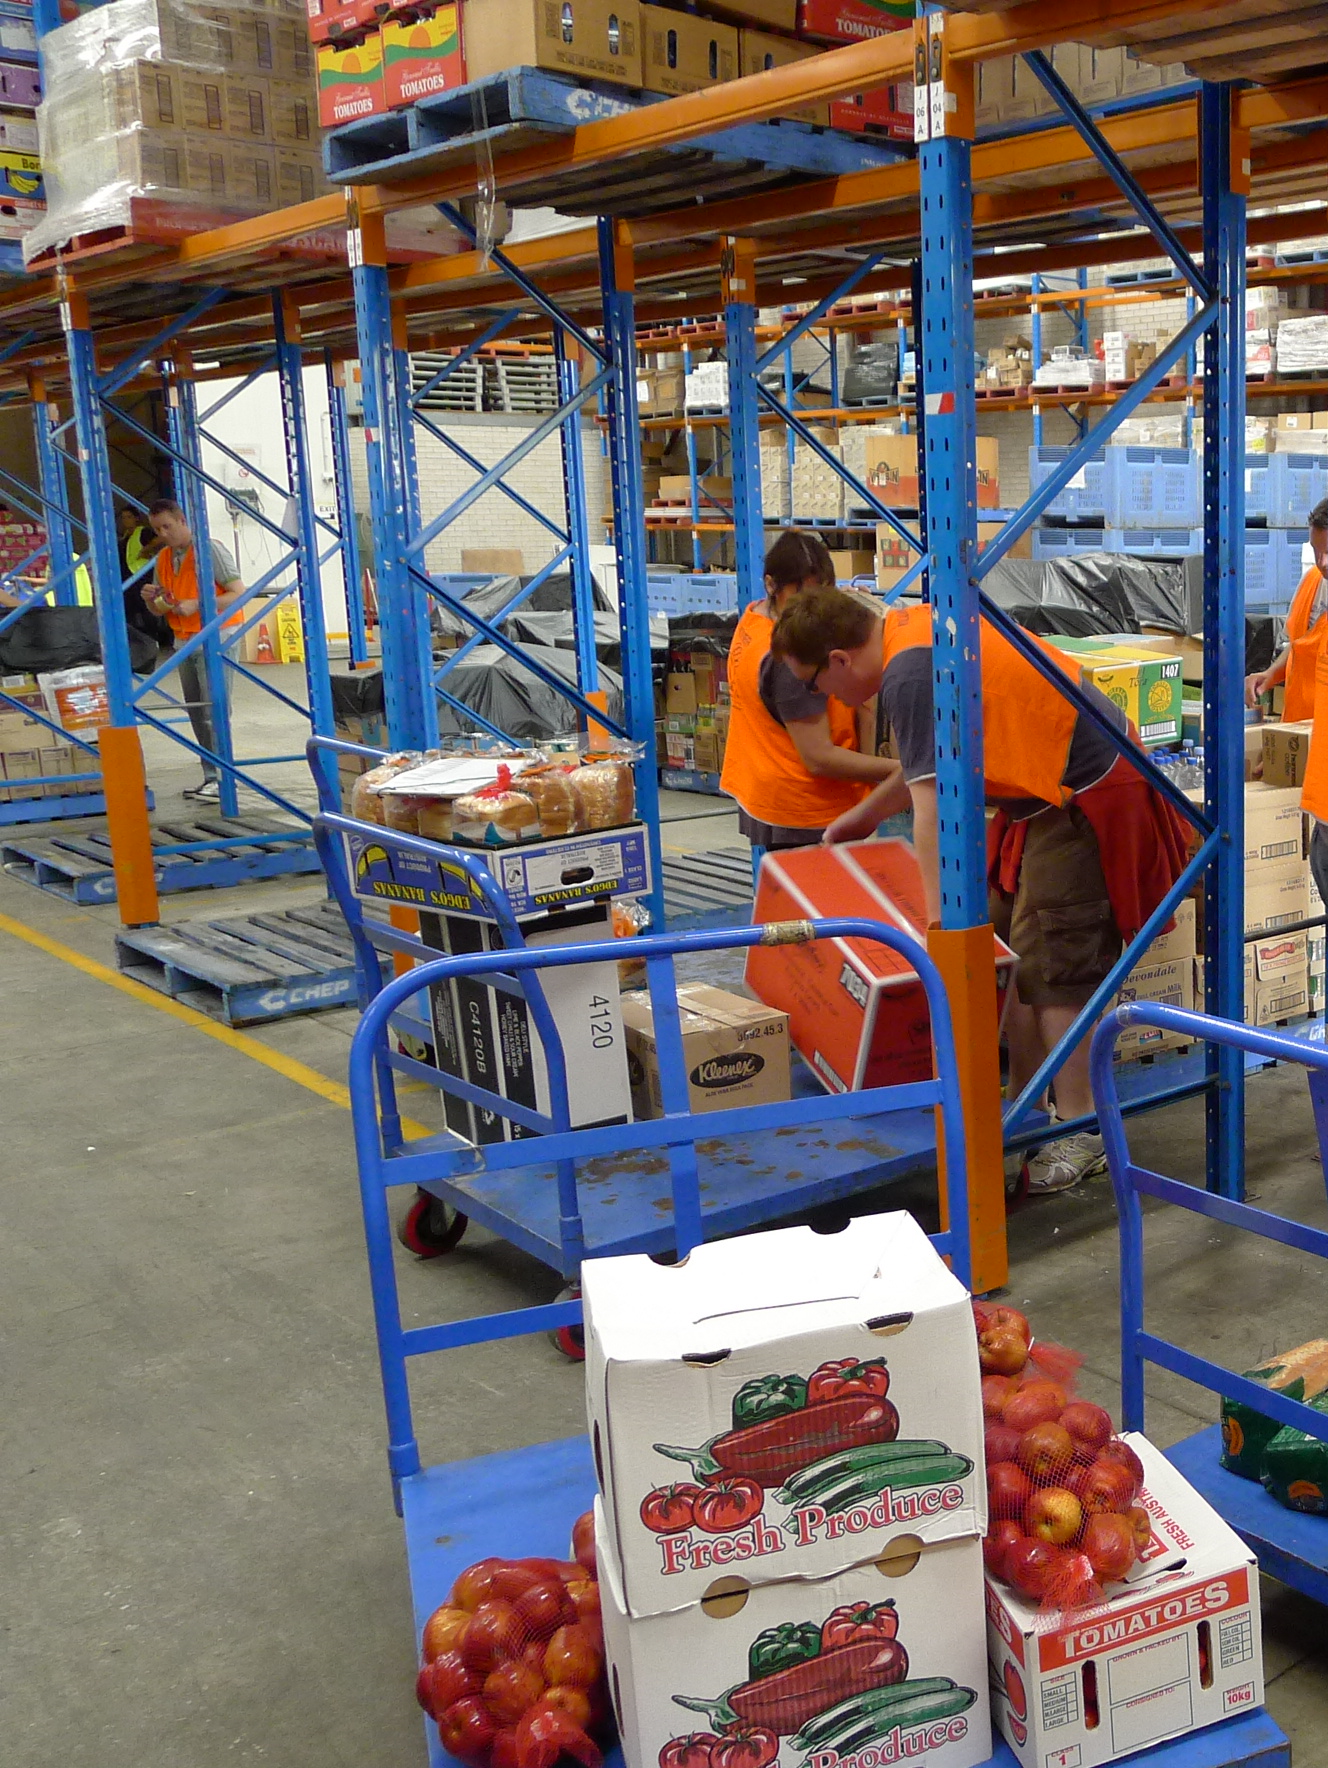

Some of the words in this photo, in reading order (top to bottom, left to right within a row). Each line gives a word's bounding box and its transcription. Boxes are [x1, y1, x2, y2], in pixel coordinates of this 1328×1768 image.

[835, 18, 891, 38] TOMATO
[399, 74, 445, 98] TOMATOES
[333, 98, 373, 119] TOMATOES
[916, 106, 925, 118] 06
[932, 103, 942, 114] 04
[917, 125, 924, 135] A
[935, 121, 941, 131] A
[319, 505, 336, 513] EXIT
[1161, 663, 1180, 679] 1407
[372, 881, 425, 903] BANANAS
[535, 887, 583, 905] BANANAS
[584, 879, 619, 896] EDGO'S
[431, 891, 471, 910] EDGO'S
[289, 979, 350, 1003] CHEP
[588, 993, 615, 1050] 4120
[469, 1001, 487, 1074] C4120B
[698, 1056, 756, 1083] Kleenex
[656, 1513, 785, 1575] Fresh
[793, 1483, 964, 1547] Produce
[1161, 1519, 1196, 1551] FRESH
[1063, 1580, 1230, 1660] TOMATOES
[1222, 1645, 1240, 1655] GREEN
[1222, 1656, 1234, 1666] RED
[1043, 1687, 1063, 1699] SMALL
[1227, 1690, 1251, 1706] 10kg
[1044, 1697, 1066, 1708] MEDIUM
[1045, 1717, 1064, 1728] LARGE
[807, 1715, 968, 1768] Produce
[1051, 1746, 1074, 1758] CLASS
[1058, 1754, 1066, 1766] 1
